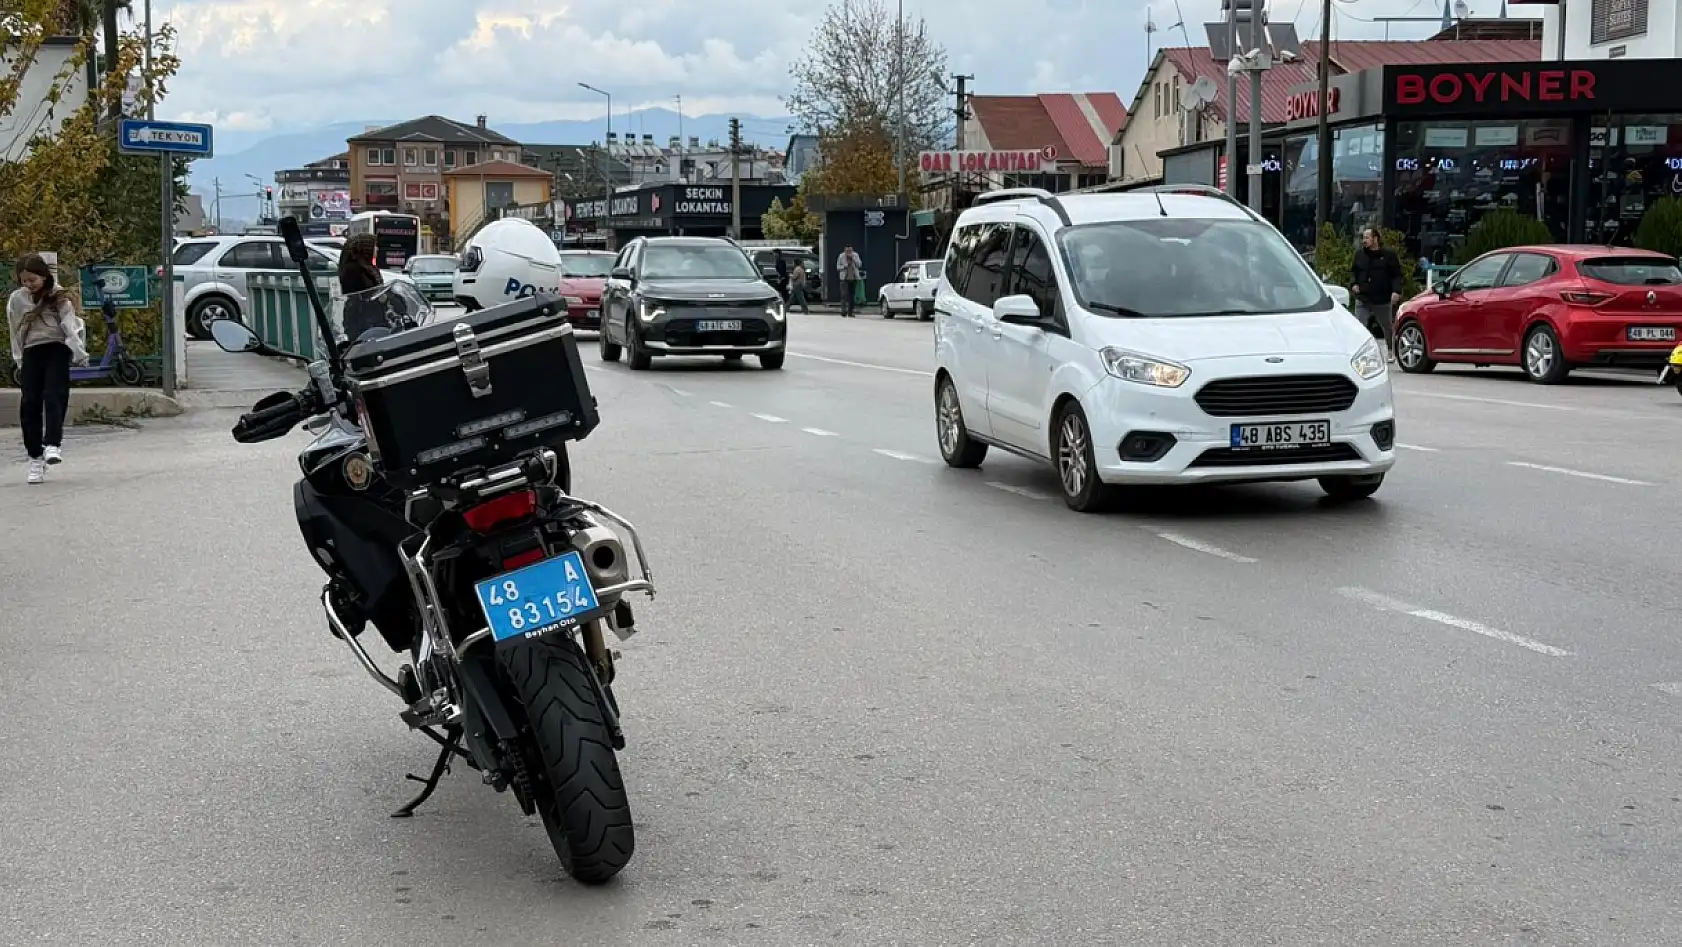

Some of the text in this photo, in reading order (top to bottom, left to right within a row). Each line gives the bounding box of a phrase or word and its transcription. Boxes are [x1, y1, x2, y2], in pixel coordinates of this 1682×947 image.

[1397, 70, 1596, 104] BOYNER
[1286, 87, 1339, 120] BOYNR
[152, 131, 172, 141] TEK
[959, 152, 1040, 171] LOKANTASI
[1632, 329, 1642, 338] 48
[1659, 329, 1673, 338] 044
[1241, 423, 1325, 444] 48 ABS 435
[489, 560, 579, 606] 48 A
[508, 586, 588, 629] 83154
